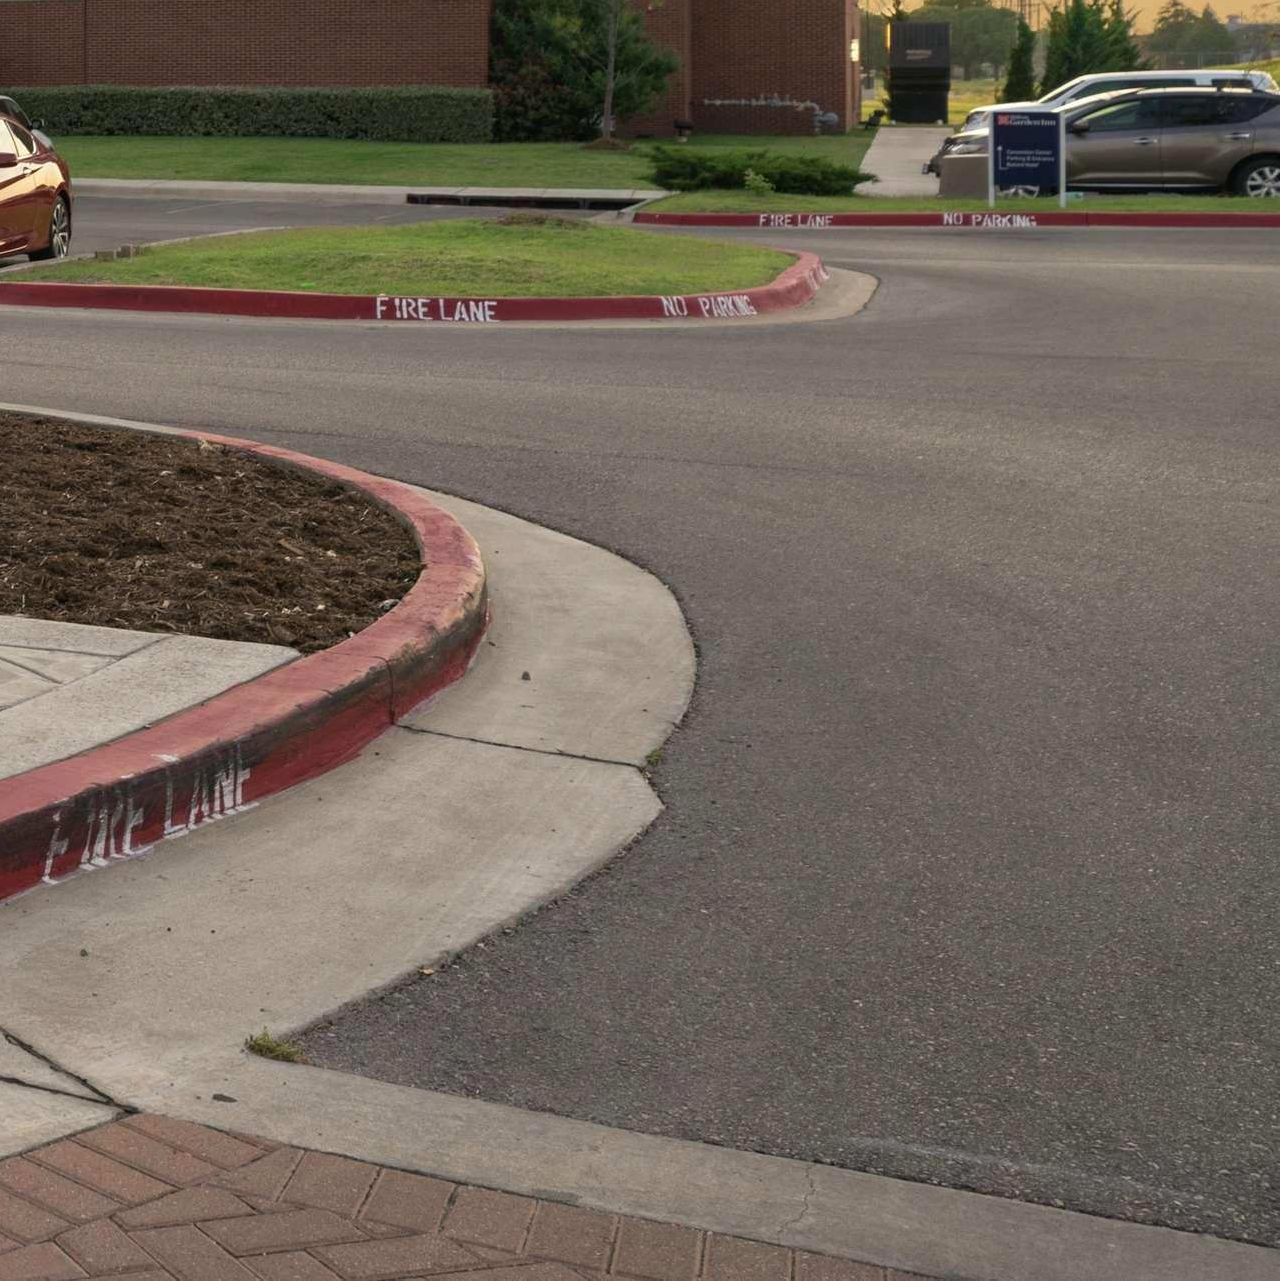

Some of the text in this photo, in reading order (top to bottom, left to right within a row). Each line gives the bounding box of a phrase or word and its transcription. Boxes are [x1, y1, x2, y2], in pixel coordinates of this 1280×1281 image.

[759, 214, 793, 227] FIRE
[943, 212, 1037, 227] NO PARKING
[375, 296, 500, 323] FIRE LANE
[660, 294, 758, 319] NO PARKING
